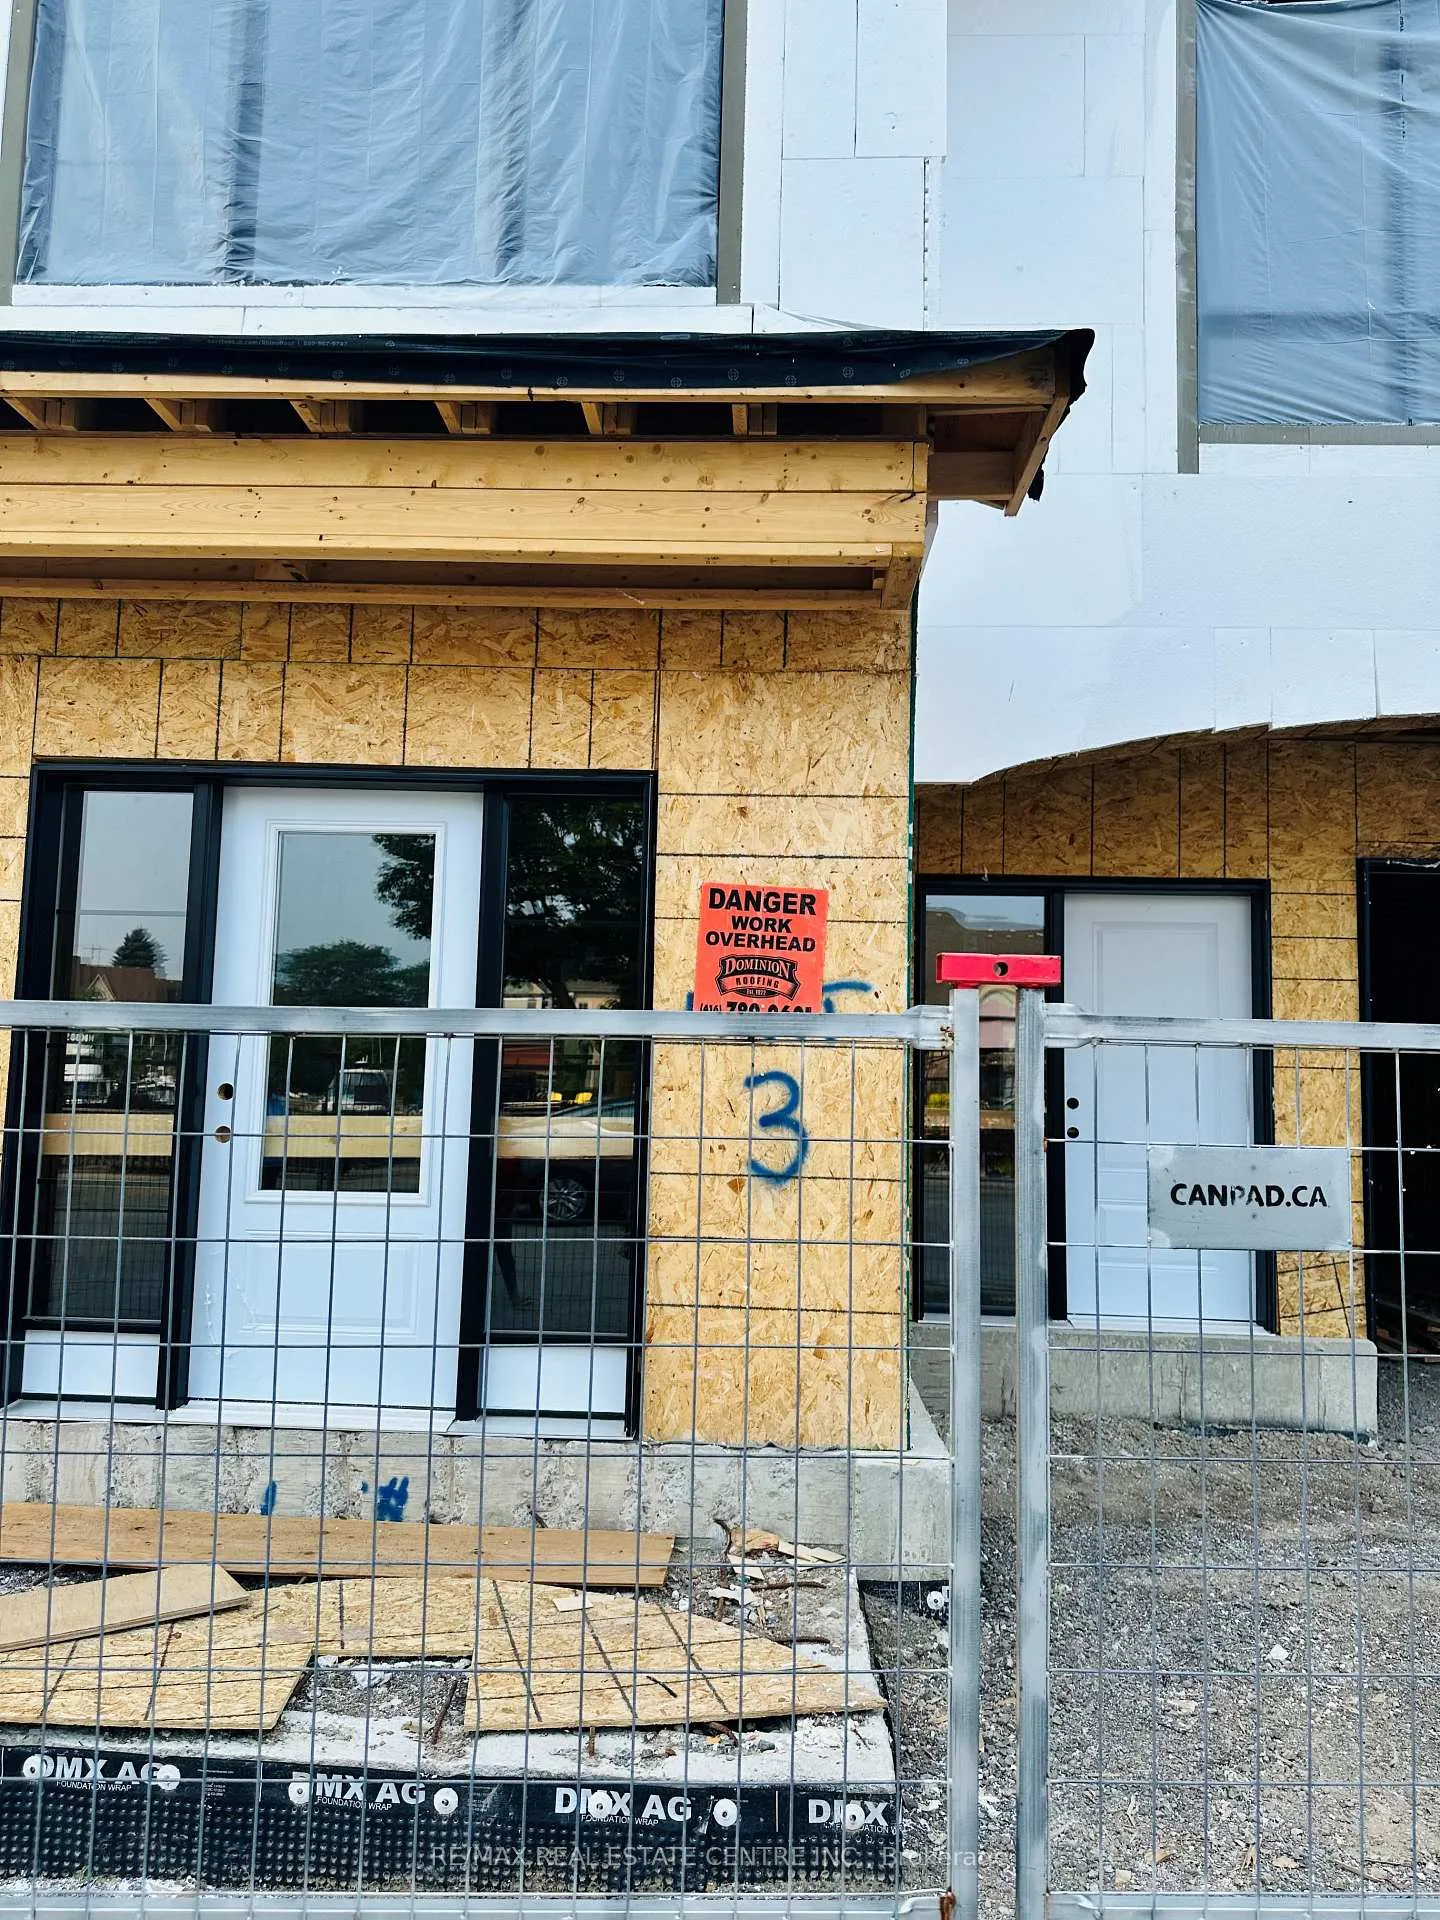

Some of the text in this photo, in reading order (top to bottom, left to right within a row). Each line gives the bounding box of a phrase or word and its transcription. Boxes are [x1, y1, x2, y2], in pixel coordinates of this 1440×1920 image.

[708, 887, 817, 916] DANGER
[731, 915, 793, 934] WORK
[705, 931, 816, 952] OVERHEAD
[724, 957, 791, 979] DOMINION
[735, 976, 780, 989] ROOFING
[743, 1070, 809, 1185] 3
[1170, 1183, 1328, 1208] CANPAD.CA
[56, 1780, 132, 1792] FOUNDATON WRAP
[376, 1781, 426, 1805] AG
[368, 1802, 392, 1811] WRAP
[642, 1794, 693, 1822] AG
[634, 1817, 659, 1826] WRAP
